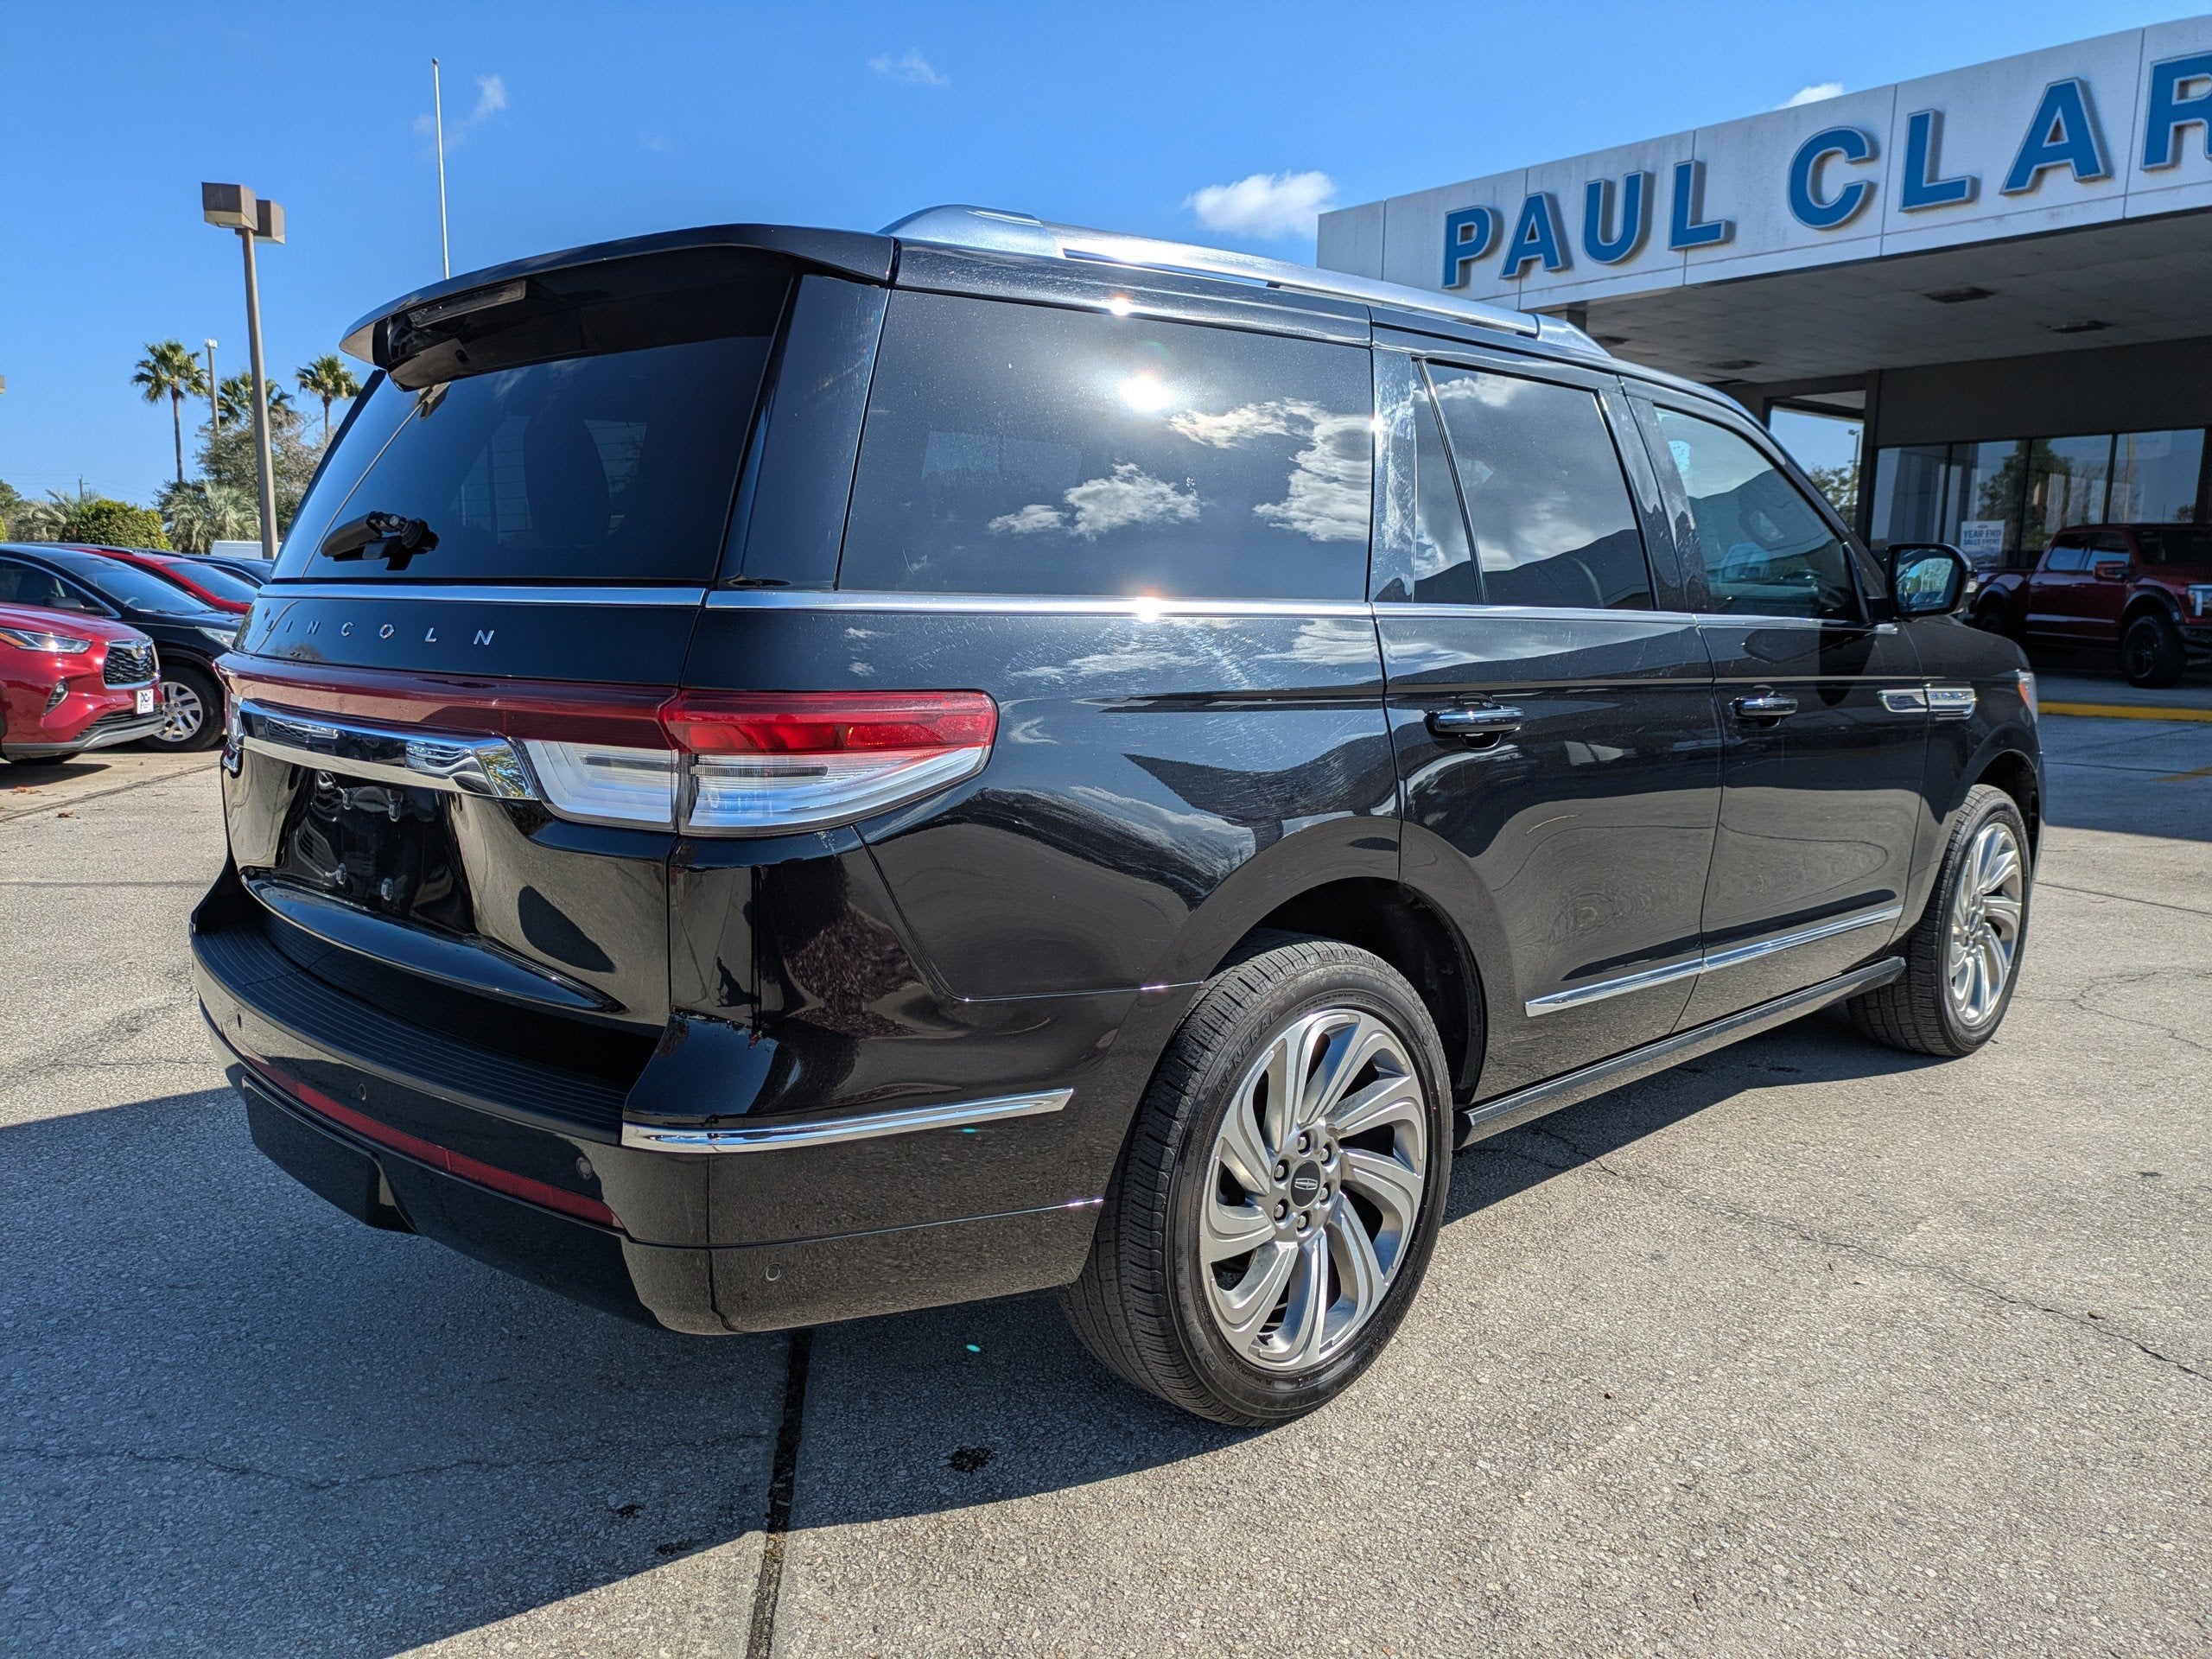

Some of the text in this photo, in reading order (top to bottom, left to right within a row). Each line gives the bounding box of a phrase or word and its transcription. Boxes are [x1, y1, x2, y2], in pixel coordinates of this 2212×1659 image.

[1442, 50, 2212, 289] PAUL CLAR
[1963, 529, 2001, 538] YEAR END
[265, 619, 495, 645] LINCOLN
